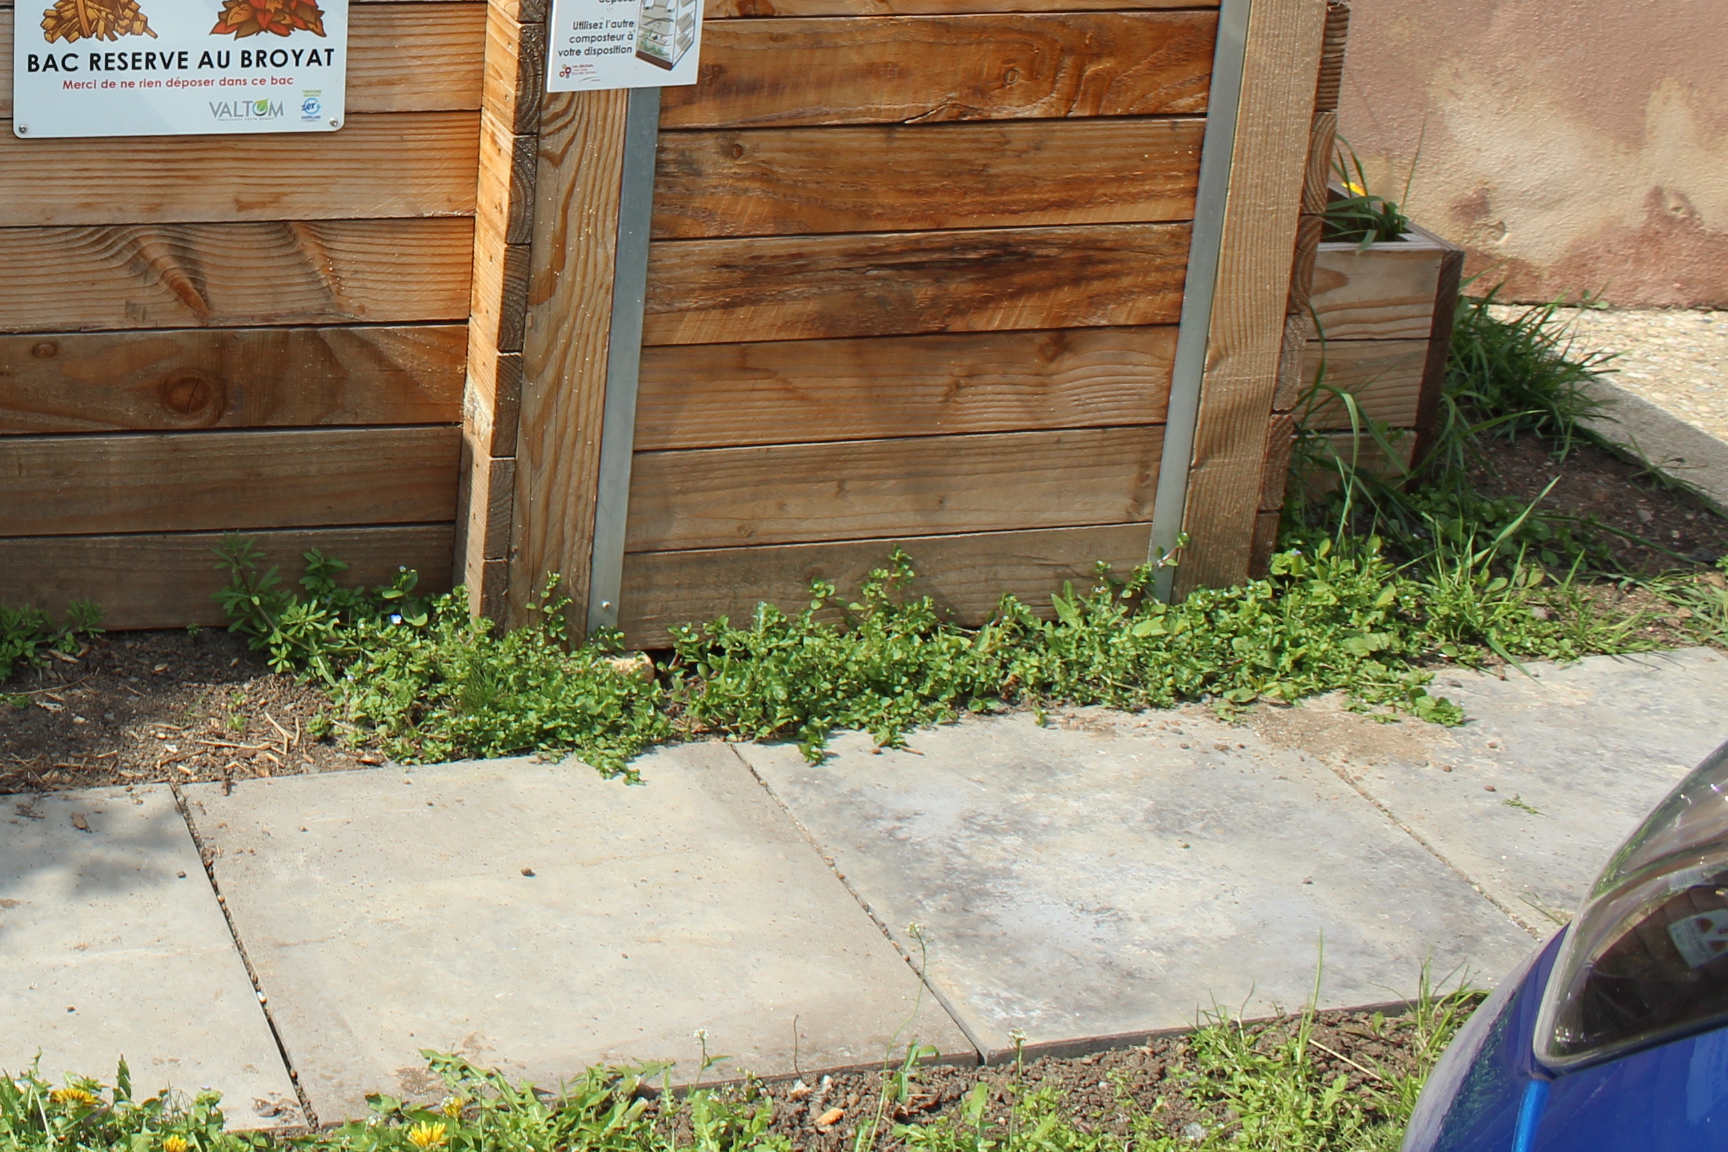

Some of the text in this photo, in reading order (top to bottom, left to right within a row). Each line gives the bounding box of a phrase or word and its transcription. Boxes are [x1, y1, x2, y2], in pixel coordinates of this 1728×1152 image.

[572, 19, 634, 30] Utilisez l'autre
[569, 30, 634, 46] composteur à
[558, 44, 632, 57] votre disposition
[27, 47, 335, 73] BAC RESERVE AU BROYAT
[62, 75, 294, 91] Merci de ne rien déposer dans ce bac
[208, 98, 285, 118] VALTOM
